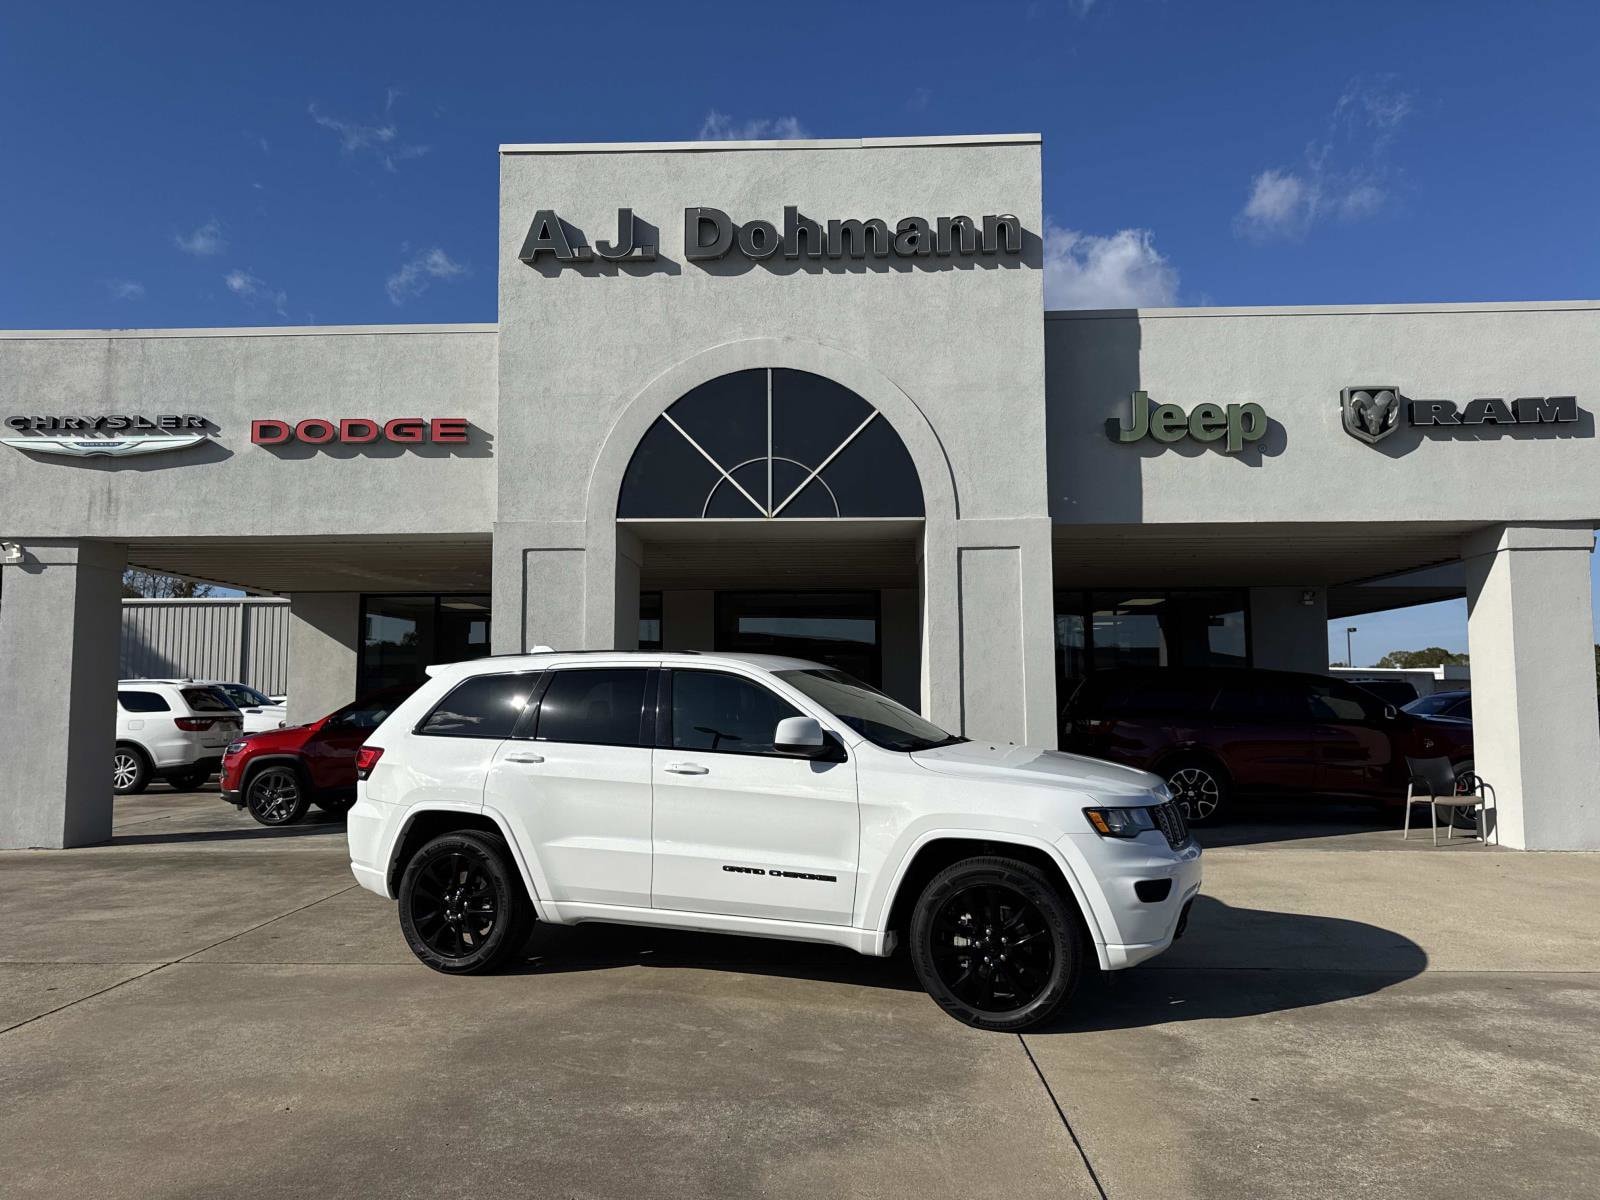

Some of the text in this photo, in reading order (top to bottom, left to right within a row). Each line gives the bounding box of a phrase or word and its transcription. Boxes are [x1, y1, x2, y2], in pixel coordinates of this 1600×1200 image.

[518, 205, 1023, 262] A.J. Dohmann
[4, 414, 204, 430] CHRYSLER
[1106, 390, 1267, 453] Jeep
[1409, 396, 1578, 426] RAM
[251, 418, 470, 444] DODGE
[722, 865, 765, 876] GRAND
